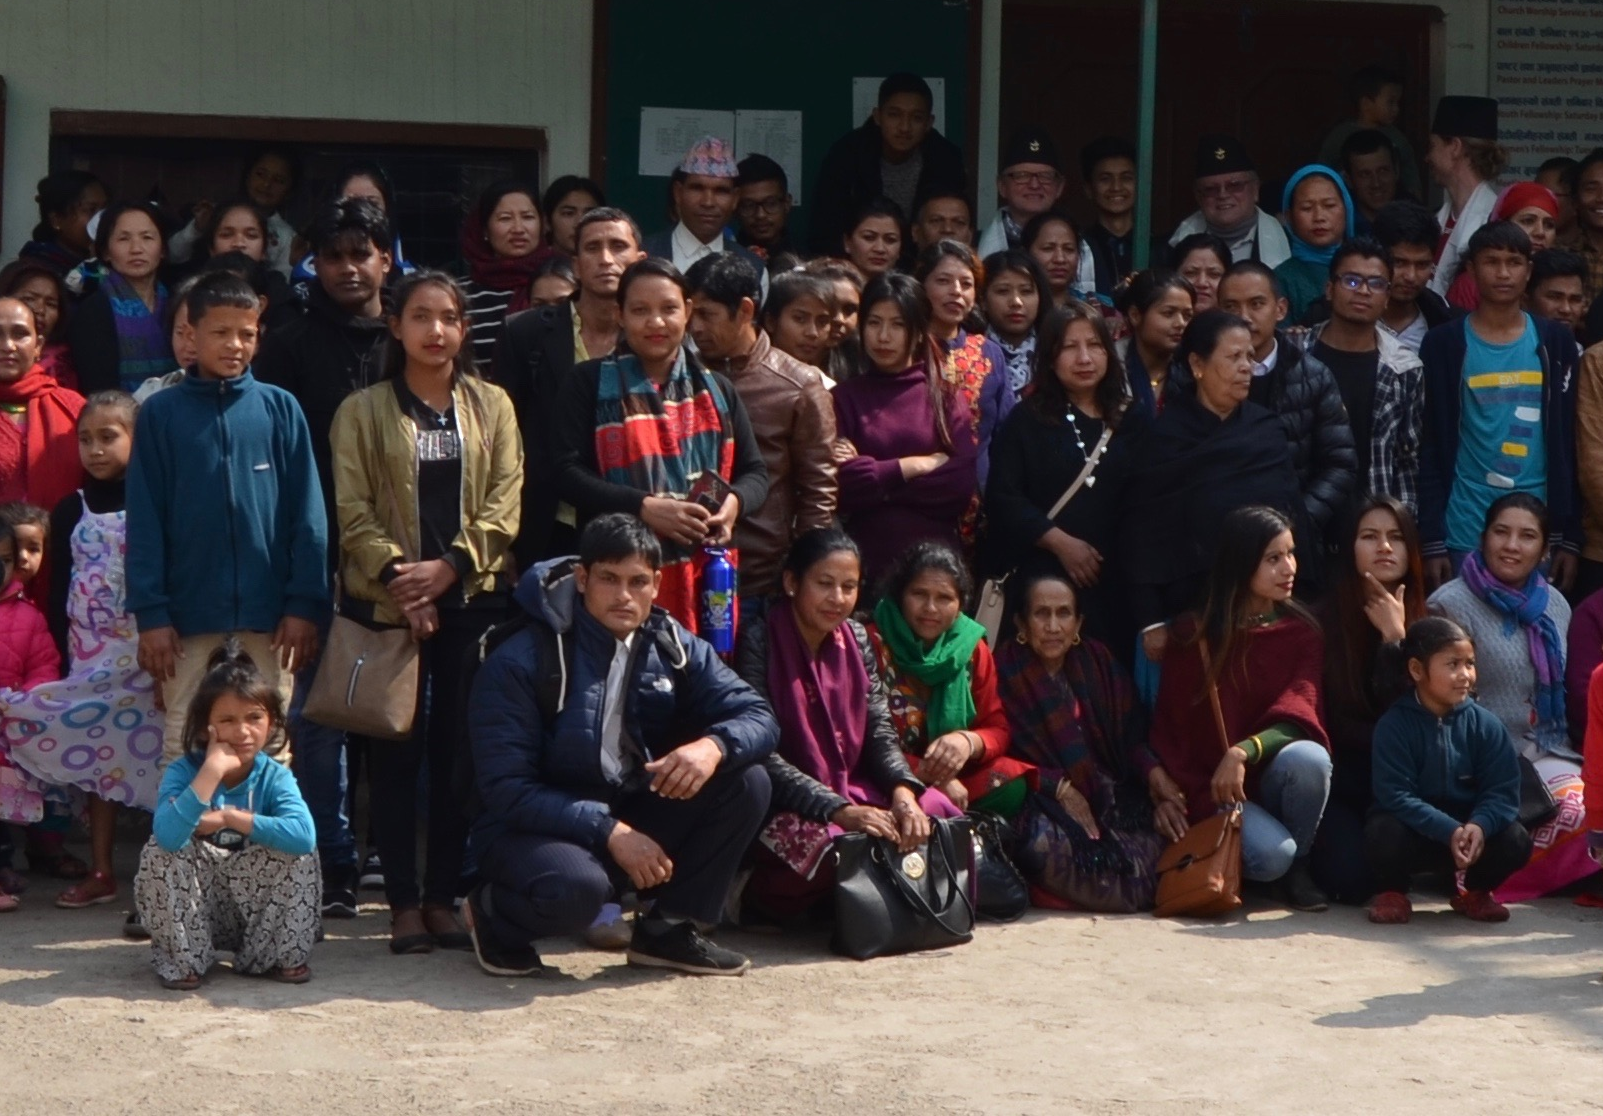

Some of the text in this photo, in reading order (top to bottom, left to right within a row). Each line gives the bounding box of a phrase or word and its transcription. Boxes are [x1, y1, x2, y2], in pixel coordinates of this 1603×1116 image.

[1498, 5, 1524, 15] Church
[1526, 7, 1557, 18] Worship
[1497, 40, 1529, 50] Children
[1519, 76, 1537, 85] and
[1538, 76, 1567, 86] Leaders
[1569, 77, 1593, 88] Prayer
[1564, 111, 1598, 122] Saturday
